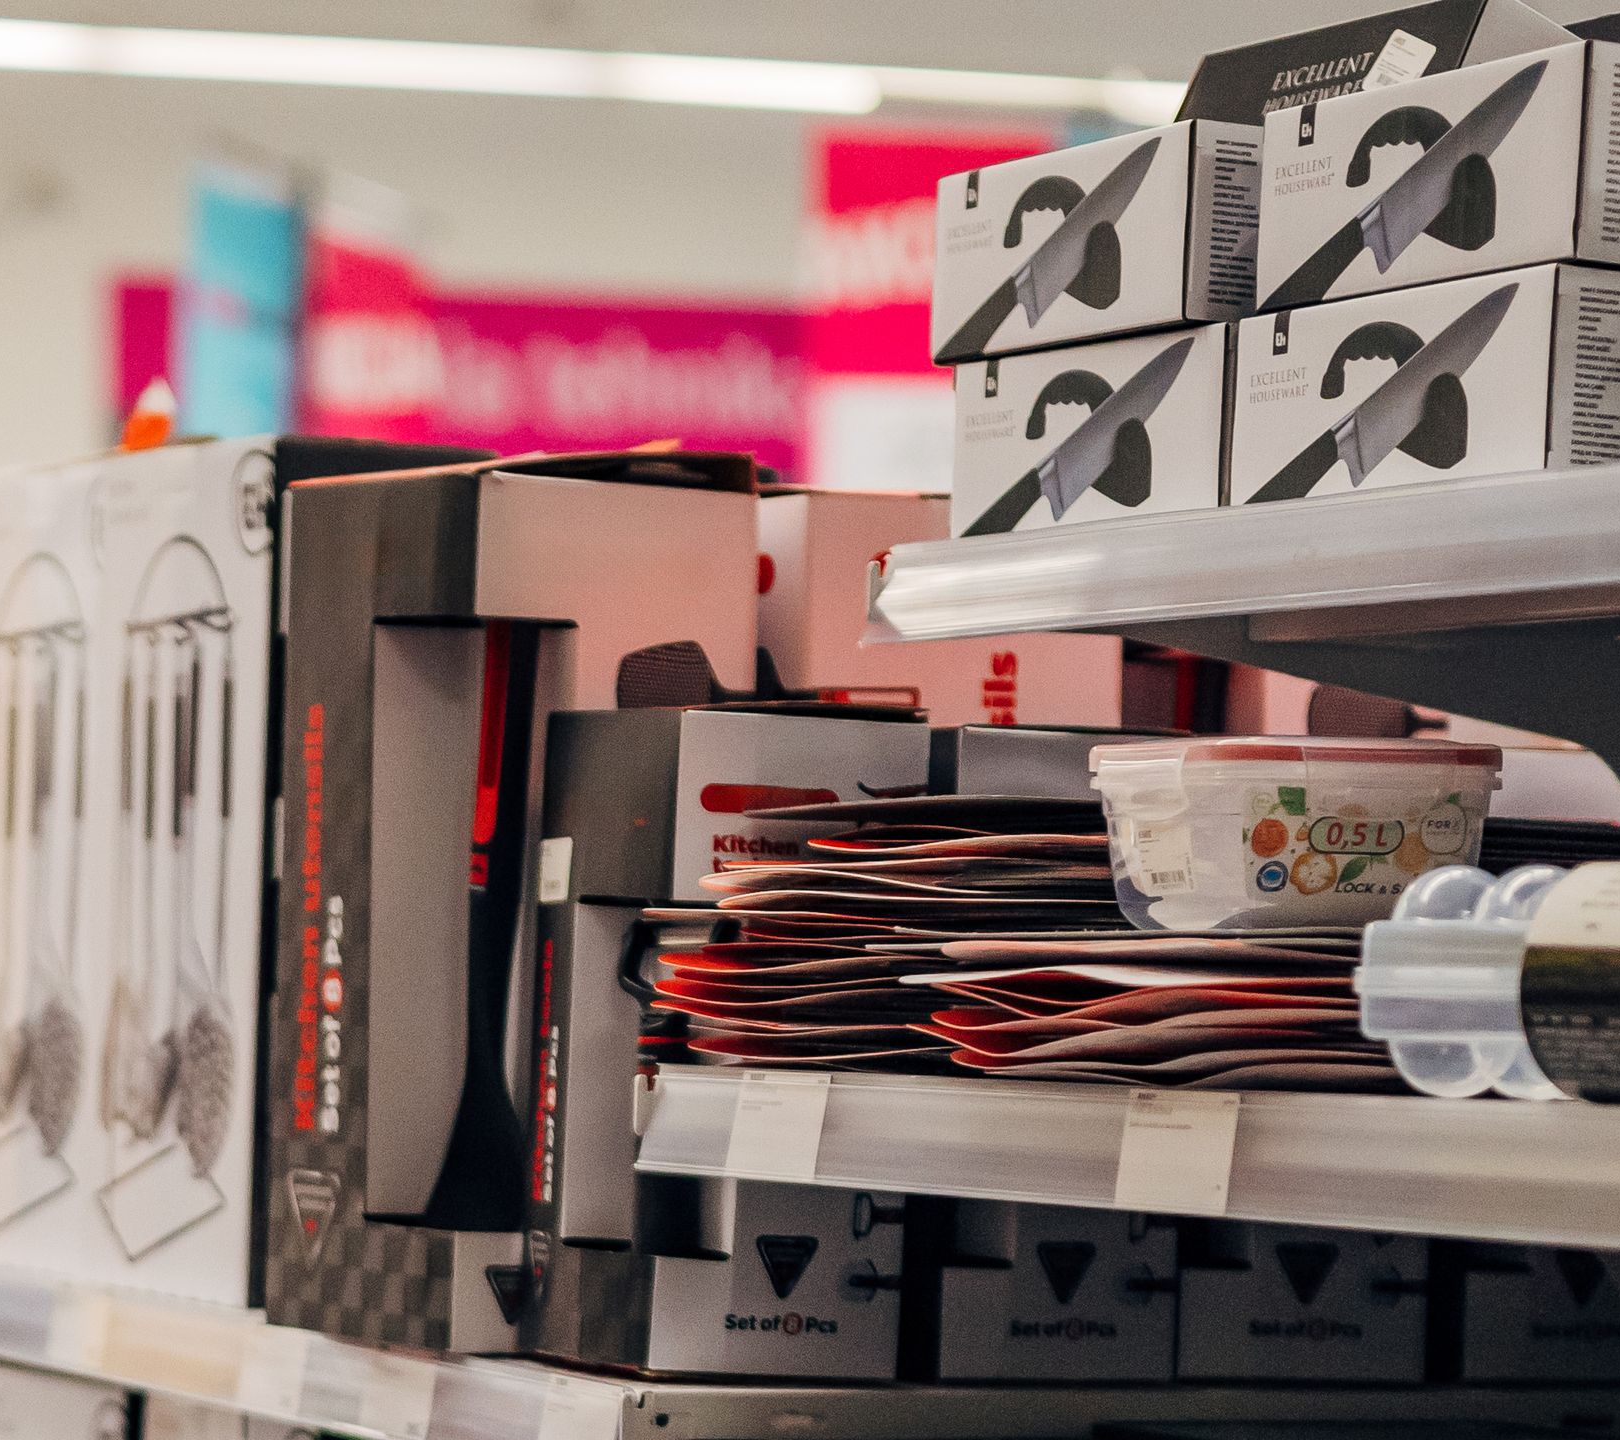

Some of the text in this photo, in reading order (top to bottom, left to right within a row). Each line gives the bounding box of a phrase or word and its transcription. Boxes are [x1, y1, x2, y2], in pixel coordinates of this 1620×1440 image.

[1271, 51, 1375, 92] EXCELLENT
[1275, 156, 1333, 181] EXCELLENT
[1250, 366, 1307, 388] EXCELLENT
[713, 833, 802, 857] Kitchen
[1326, 821, 1390, 847] 0,5 L
[1334, 878, 1374, 894] LOCK
[294, 702, 325, 1131] Kitchen utensils
[321, 1013, 342, 1062] of
[319, 1063, 342, 1134] Set
[724, 1313, 756, 1331] Set
[760, 1315, 782, 1331] of
[805, 1316, 839, 1334] Pcs
